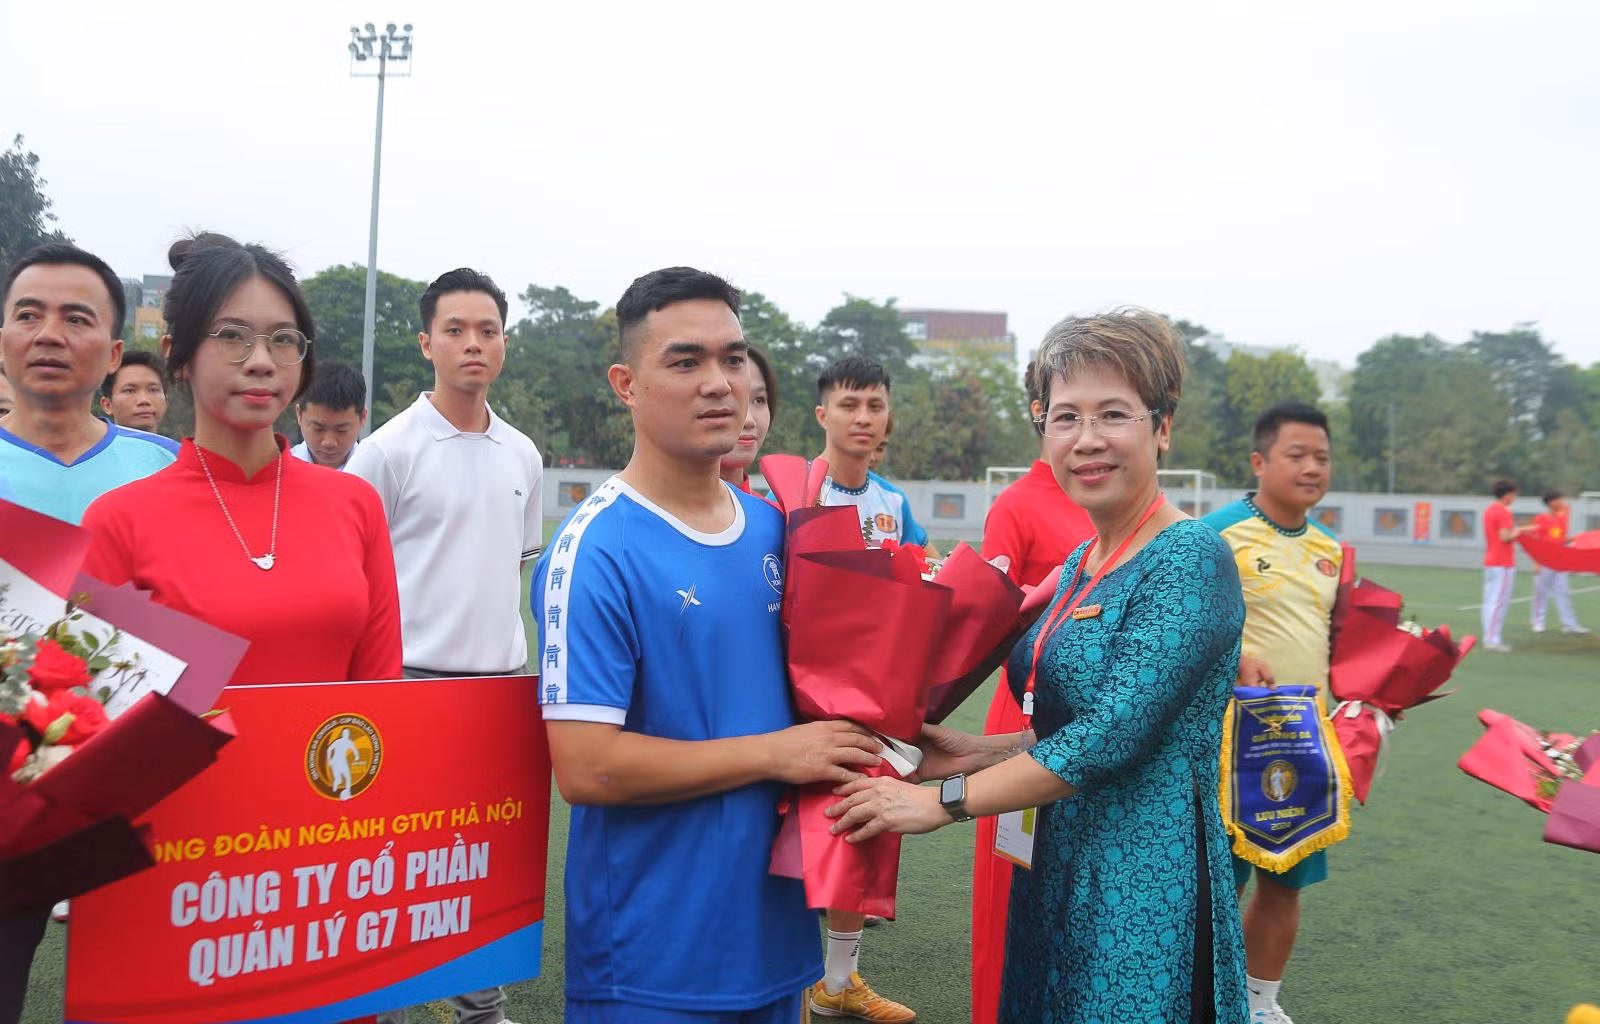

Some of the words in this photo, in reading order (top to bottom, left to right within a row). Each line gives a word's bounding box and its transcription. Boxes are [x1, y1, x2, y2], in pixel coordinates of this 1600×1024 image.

[214, 824, 292, 857] ĐOÀN
[298, 815, 385, 847] NGÀNH
[392, 809, 446, 834] GTVT
[450, 801, 480, 828] HÀ
[486, 796, 523, 826] NỘI
[171, 870, 281, 927] CÔNG
[292, 862, 338, 909] TY
[347, 841, 395, 900] CỔ
[405, 833, 490, 891] PHẦN
[188, 919, 296, 987] QUẢN
[305, 910, 347, 962] LÝ
[356, 907, 399, 953] G7
[407, 895, 472, 943] TAXI
